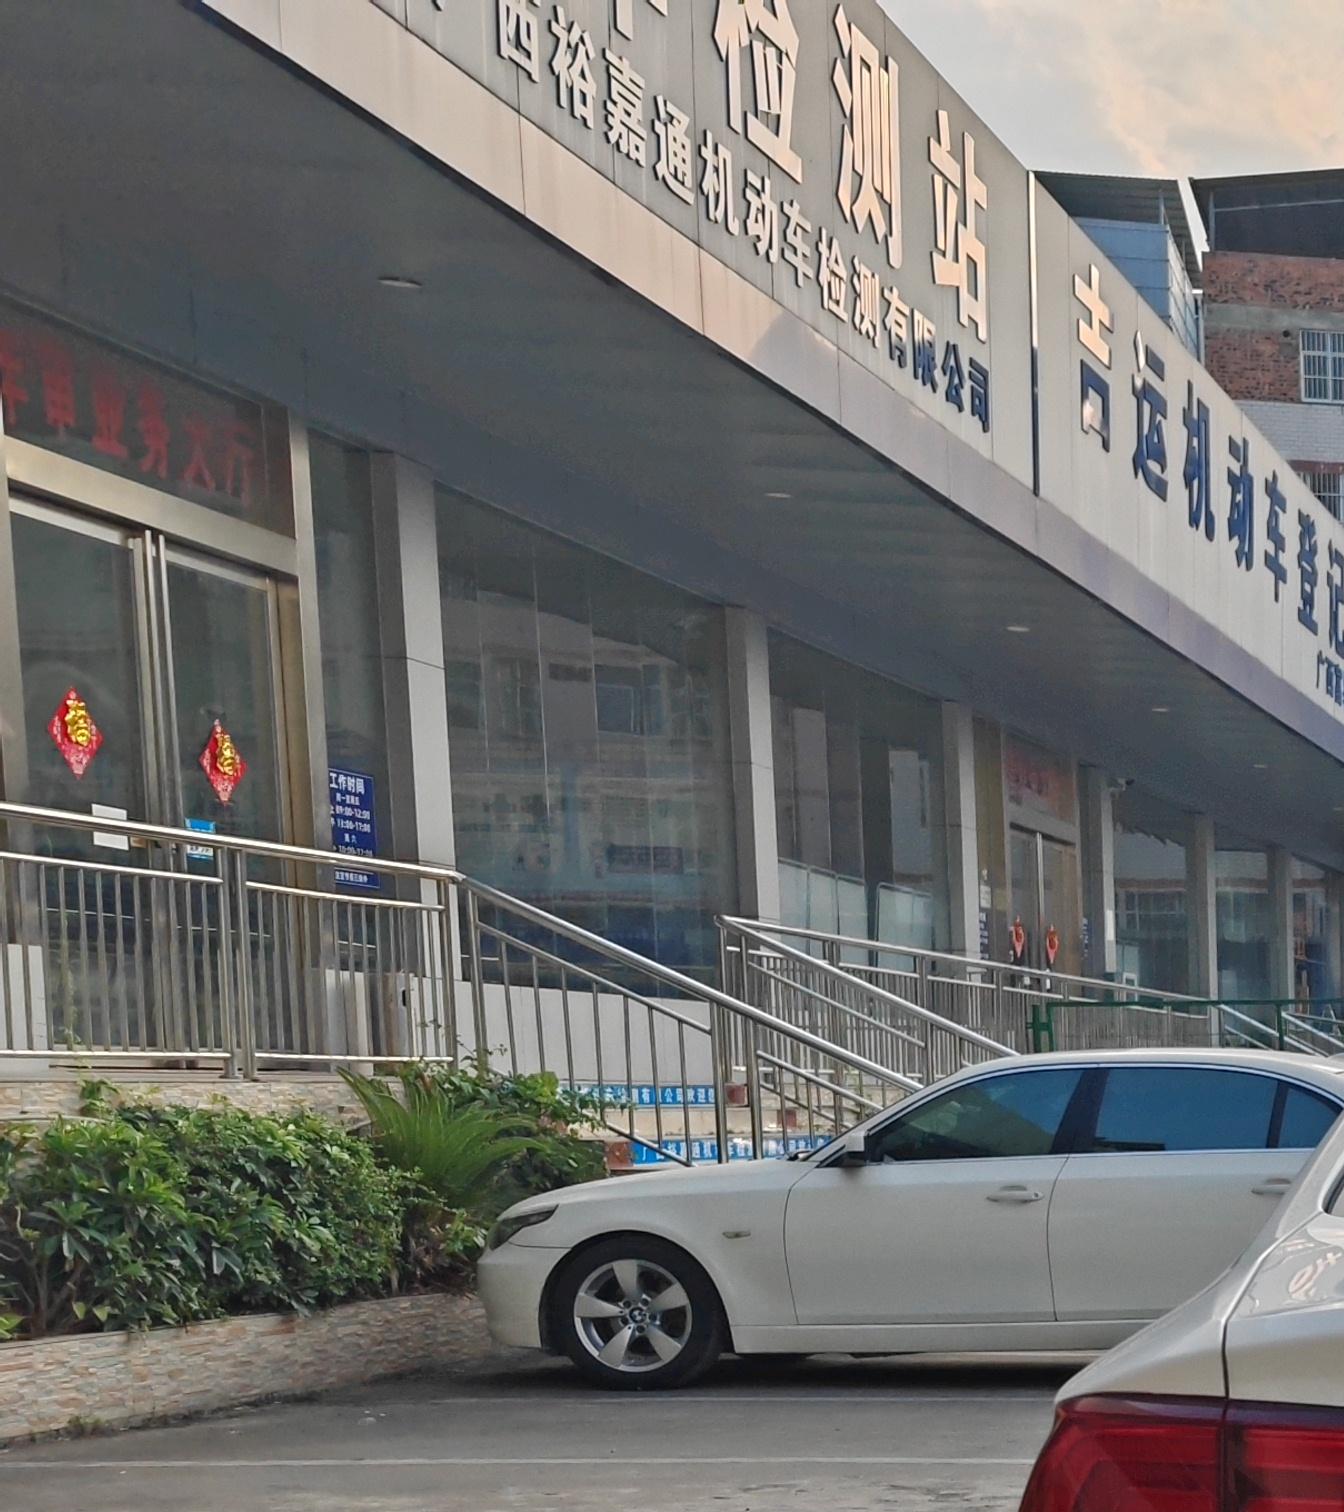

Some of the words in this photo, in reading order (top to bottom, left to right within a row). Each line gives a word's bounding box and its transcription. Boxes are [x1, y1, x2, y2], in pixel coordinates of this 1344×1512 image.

[413, 0, 990, 434] 西裕嘉通机动车检测有限公司
[611, 0, 988, 343] 检测站
